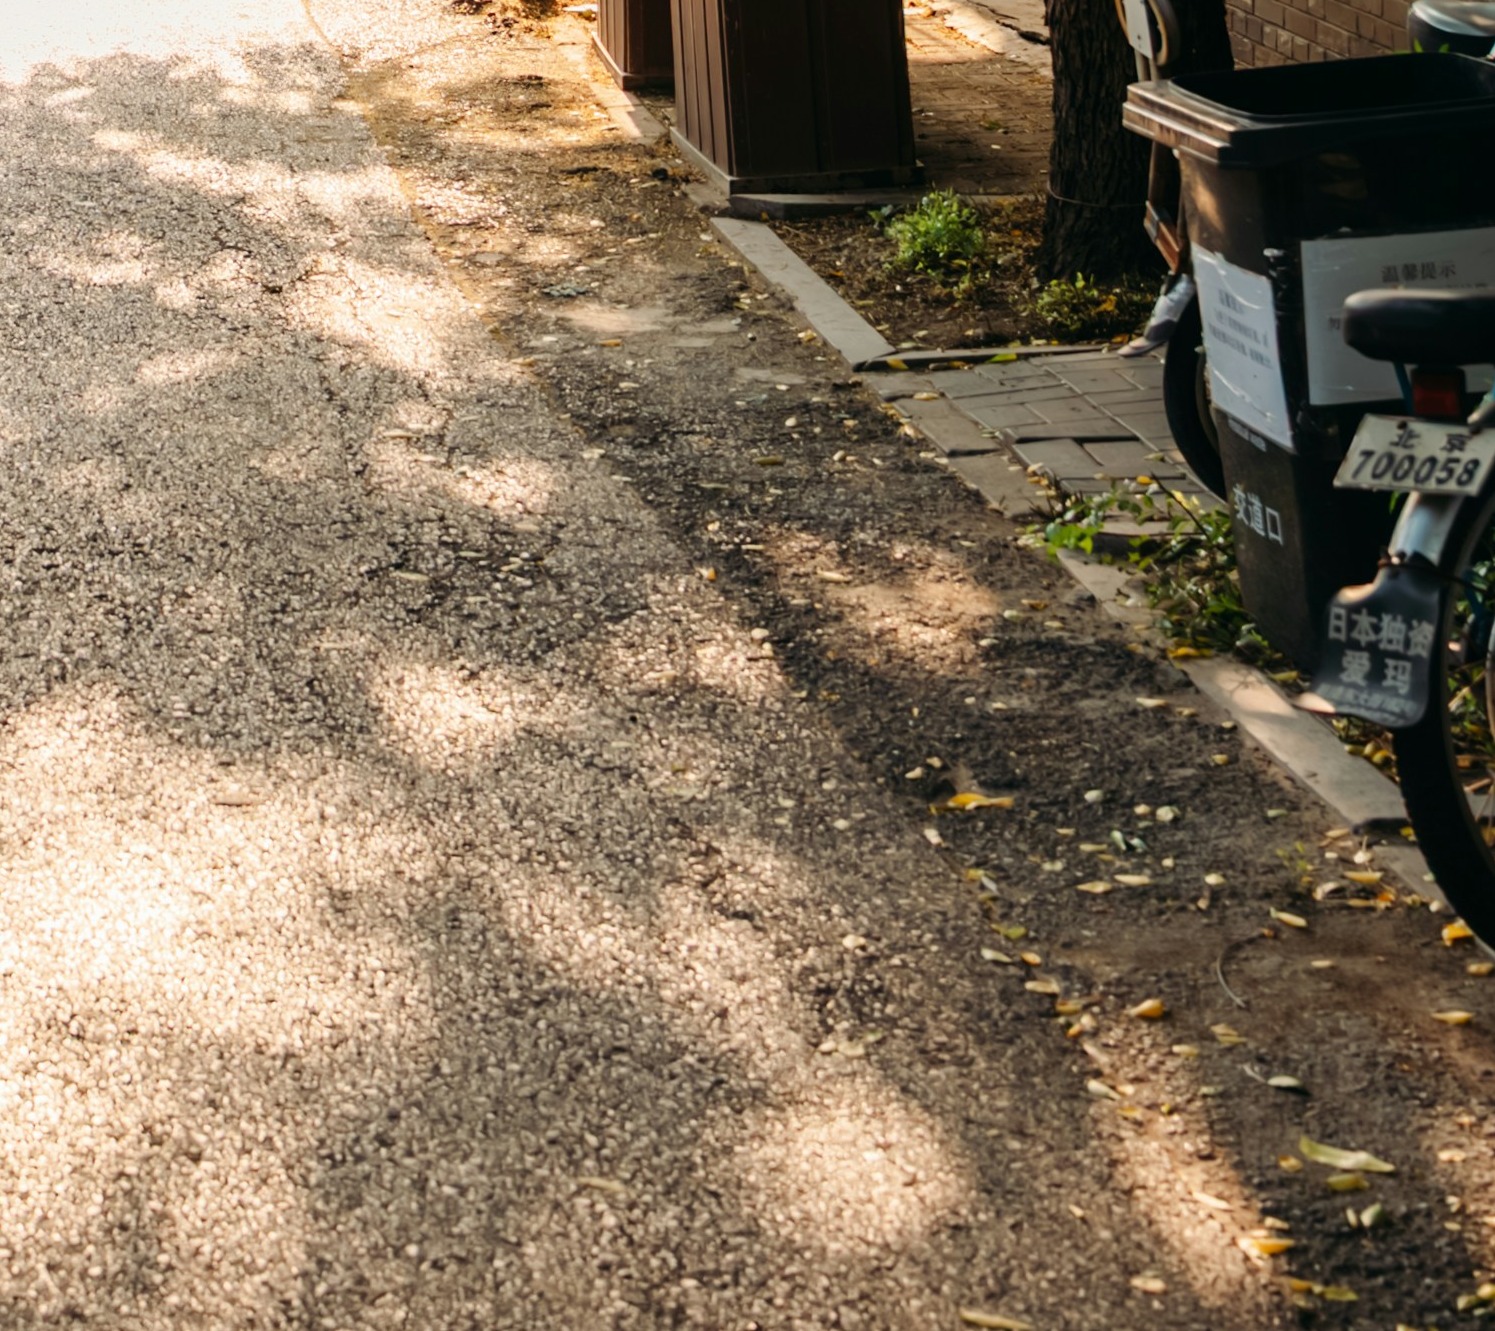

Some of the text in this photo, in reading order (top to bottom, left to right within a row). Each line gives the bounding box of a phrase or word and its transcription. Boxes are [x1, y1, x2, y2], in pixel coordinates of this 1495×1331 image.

[1380, 260, 1457, 283] 温馨提示
[1389, 426, 1474, 453] 北京
[1351, 450, 1482, 487] 700058
[1233, 482, 1283, 546] 交道口
[1328, 606, 1435, 658] 日本独资
[1339, 650, 1412, 694] 爱玛
